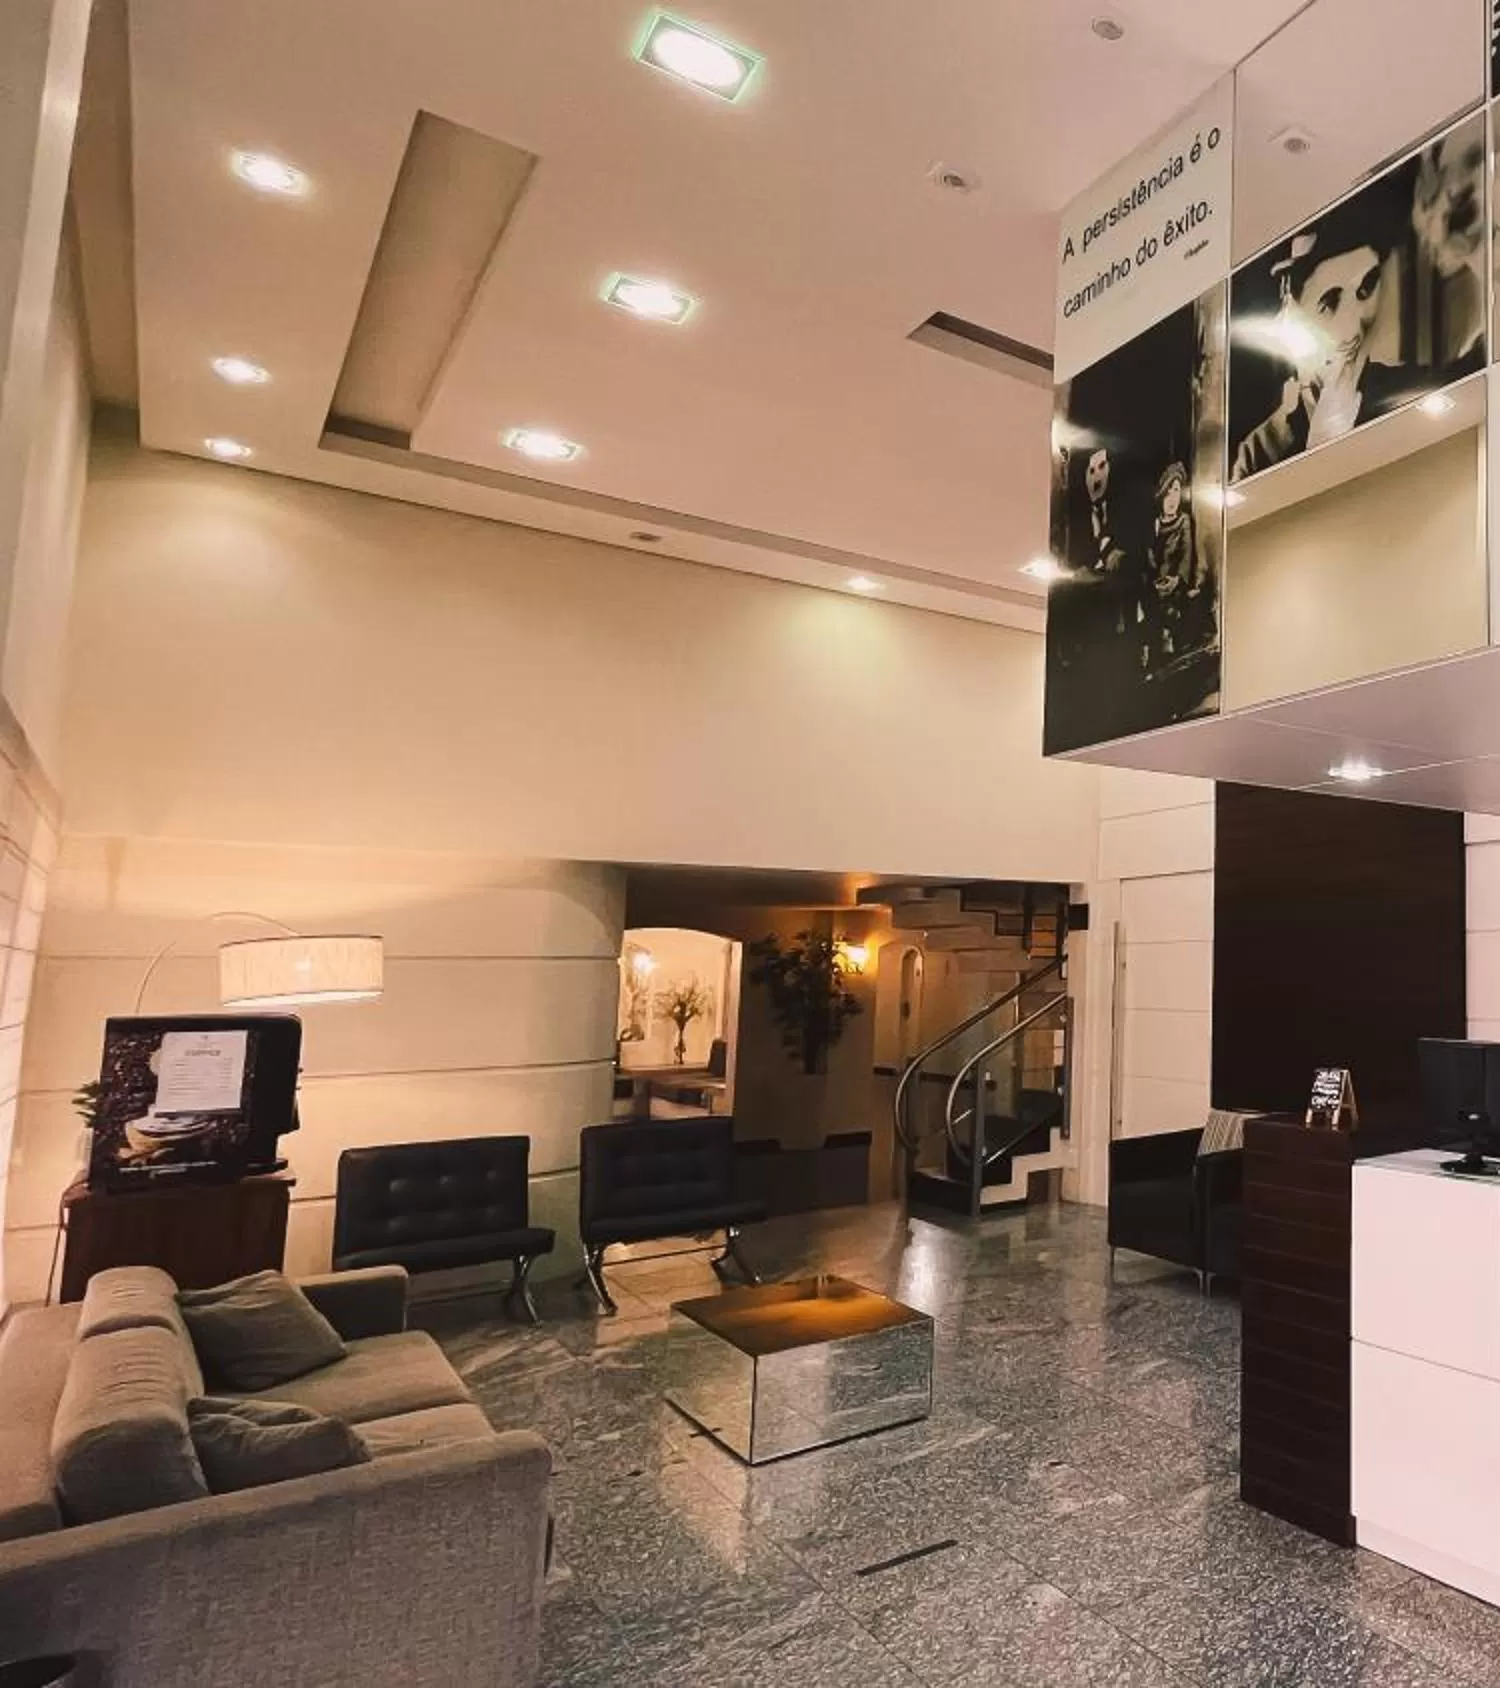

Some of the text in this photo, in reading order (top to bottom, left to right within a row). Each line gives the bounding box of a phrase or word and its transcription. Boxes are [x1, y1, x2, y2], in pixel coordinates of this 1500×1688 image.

[1061, 236, 1075, 265] A
[1083, 155, 1184, 253] persistência
[1189, 133, 1201, 164] é
[1207, 127, 1221, 150] o
[1063, 256, 1131, 318] caminho
[1135, 237, 1159, 266] do
[1163, 200, 1213, 247] êxito.
